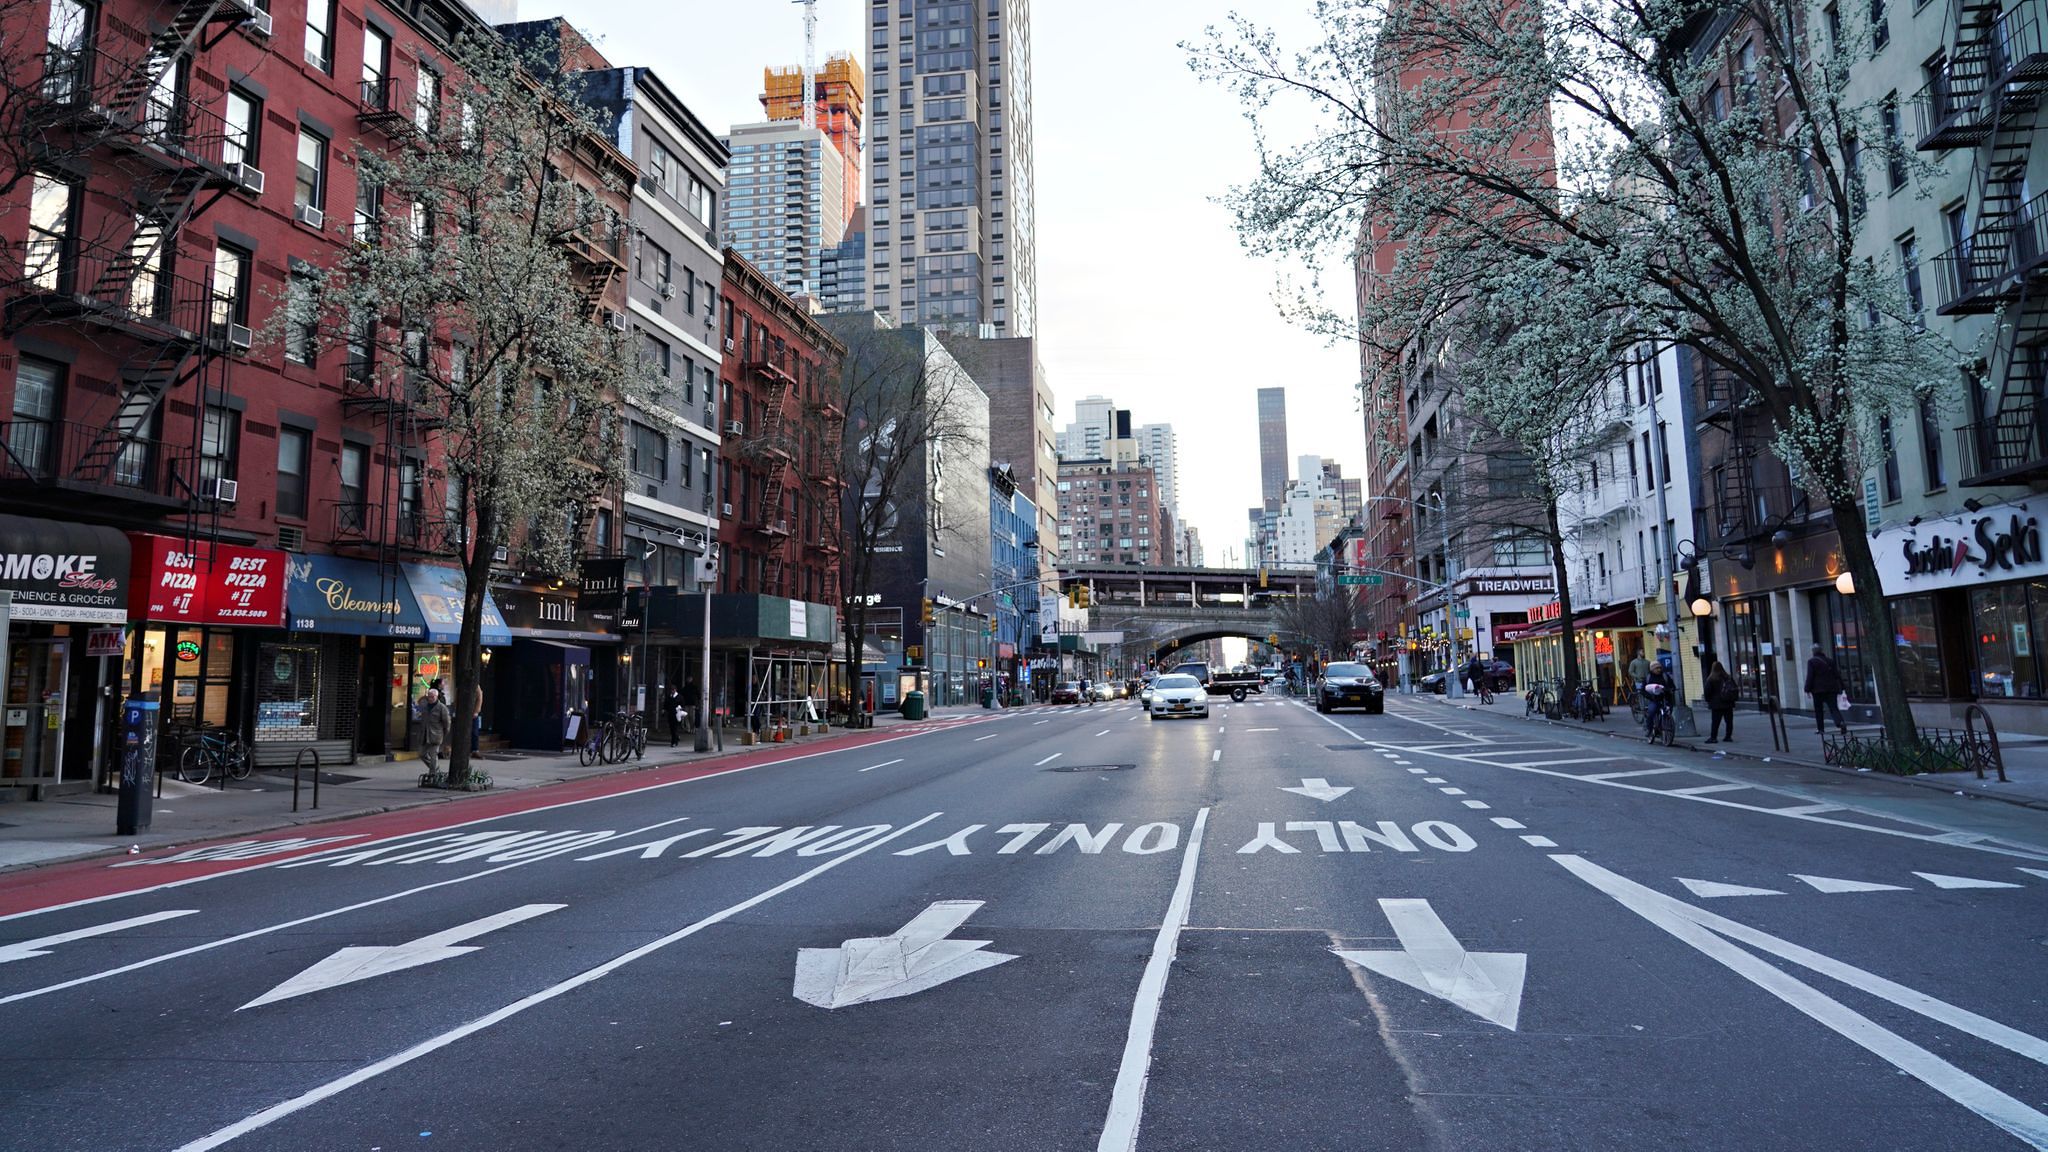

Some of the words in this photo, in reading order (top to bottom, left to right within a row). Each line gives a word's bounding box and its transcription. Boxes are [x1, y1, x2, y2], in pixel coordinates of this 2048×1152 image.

[1902, 535, 1953, 580] Sushi
[1971, 514, 2042, 577] Seki
[0, 553, 97, 580] MOKE
[165, 551, 195, 569] BEST
[230, 557, 267, 571] BEST
[58, 571, 118, 594] Shop
[161, 572, 197, 590] PIZZA
[224, 573, 267, 588] PIZZA
[584, 577, 617, 590] imli
[1476, 580, 1555, 592] TREADWELL
[60, 593, 66, 602] &
[69, 594, 116, 605] GROCERY
[316, 577, 401, 615] Cleaners
[539, 596, 575, 622] imli
[296, 620, 314, 629] 1138
[177, 641, 199, 655] PIZZA
[574, 824, 893, 862] ONLY
[892, 822, 1180, 856] ONLY
[1236, 820, 1479, 854] ONLY
